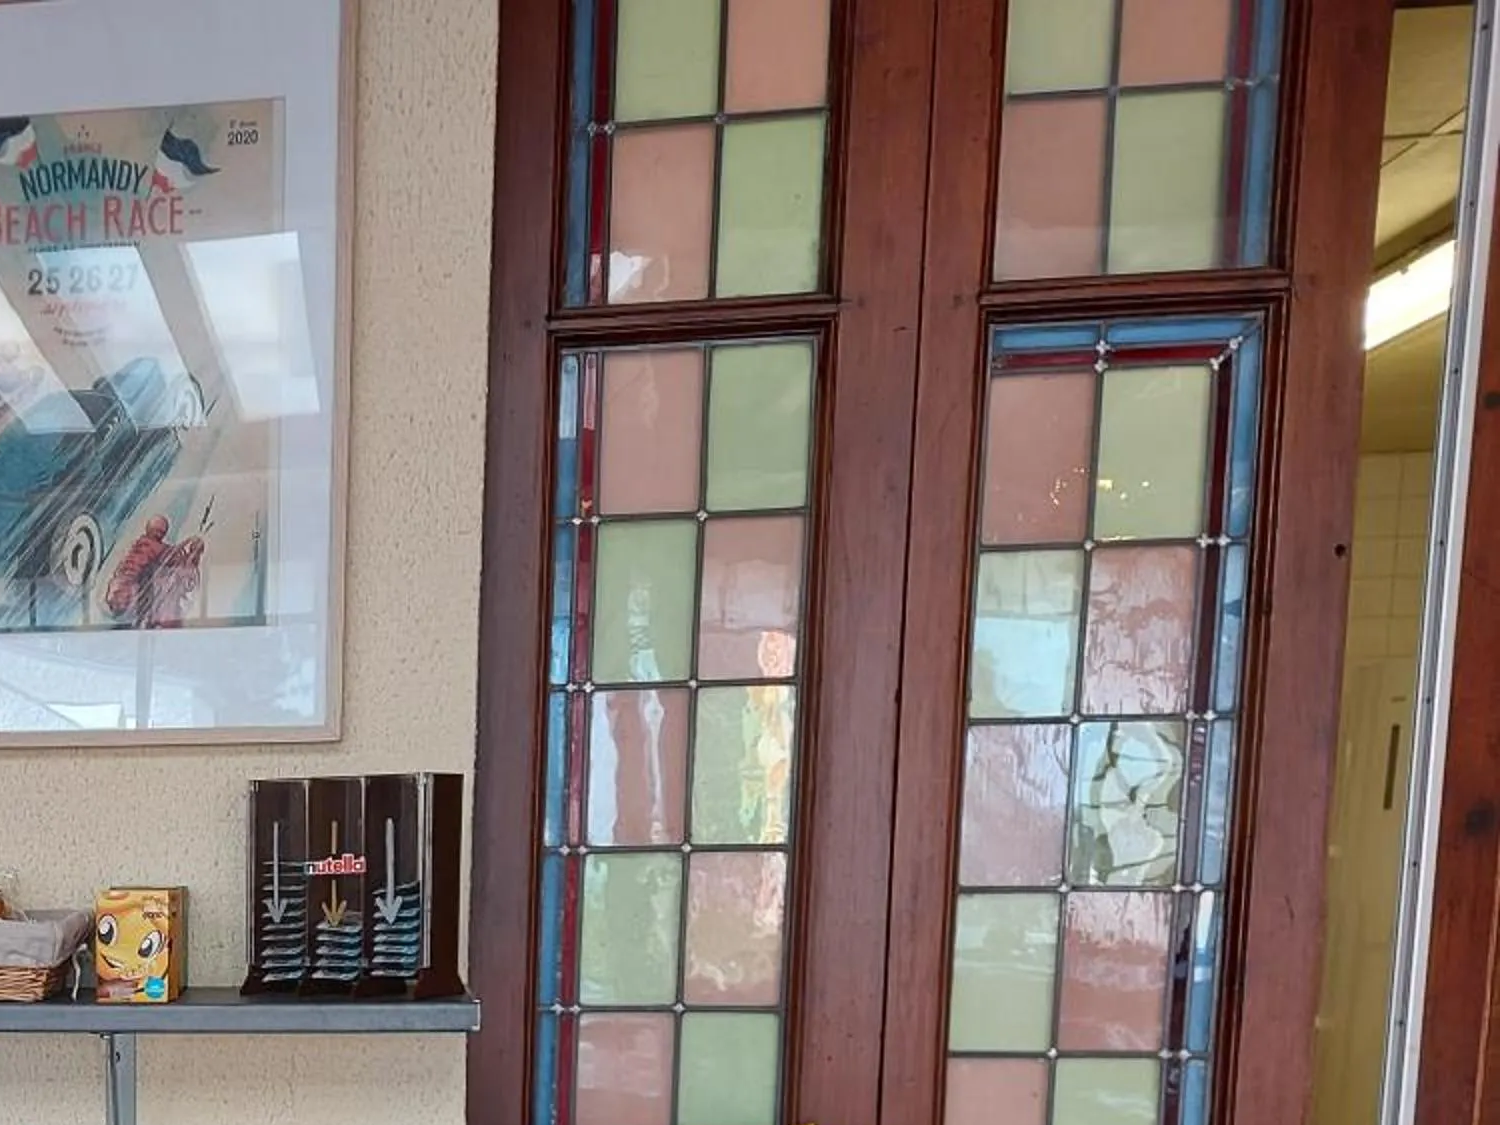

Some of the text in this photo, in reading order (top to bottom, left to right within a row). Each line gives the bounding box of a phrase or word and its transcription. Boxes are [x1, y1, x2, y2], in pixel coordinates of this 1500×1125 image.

[227, 129, 260, 145] 2020
[18, 158, 149, 202] NORMANDY
[103, 195, 184, 238] RACE
[27, 267, 61, 296] 25
[68, 264, 104, 294] 26
[304, 854, 366, 875] nutella
